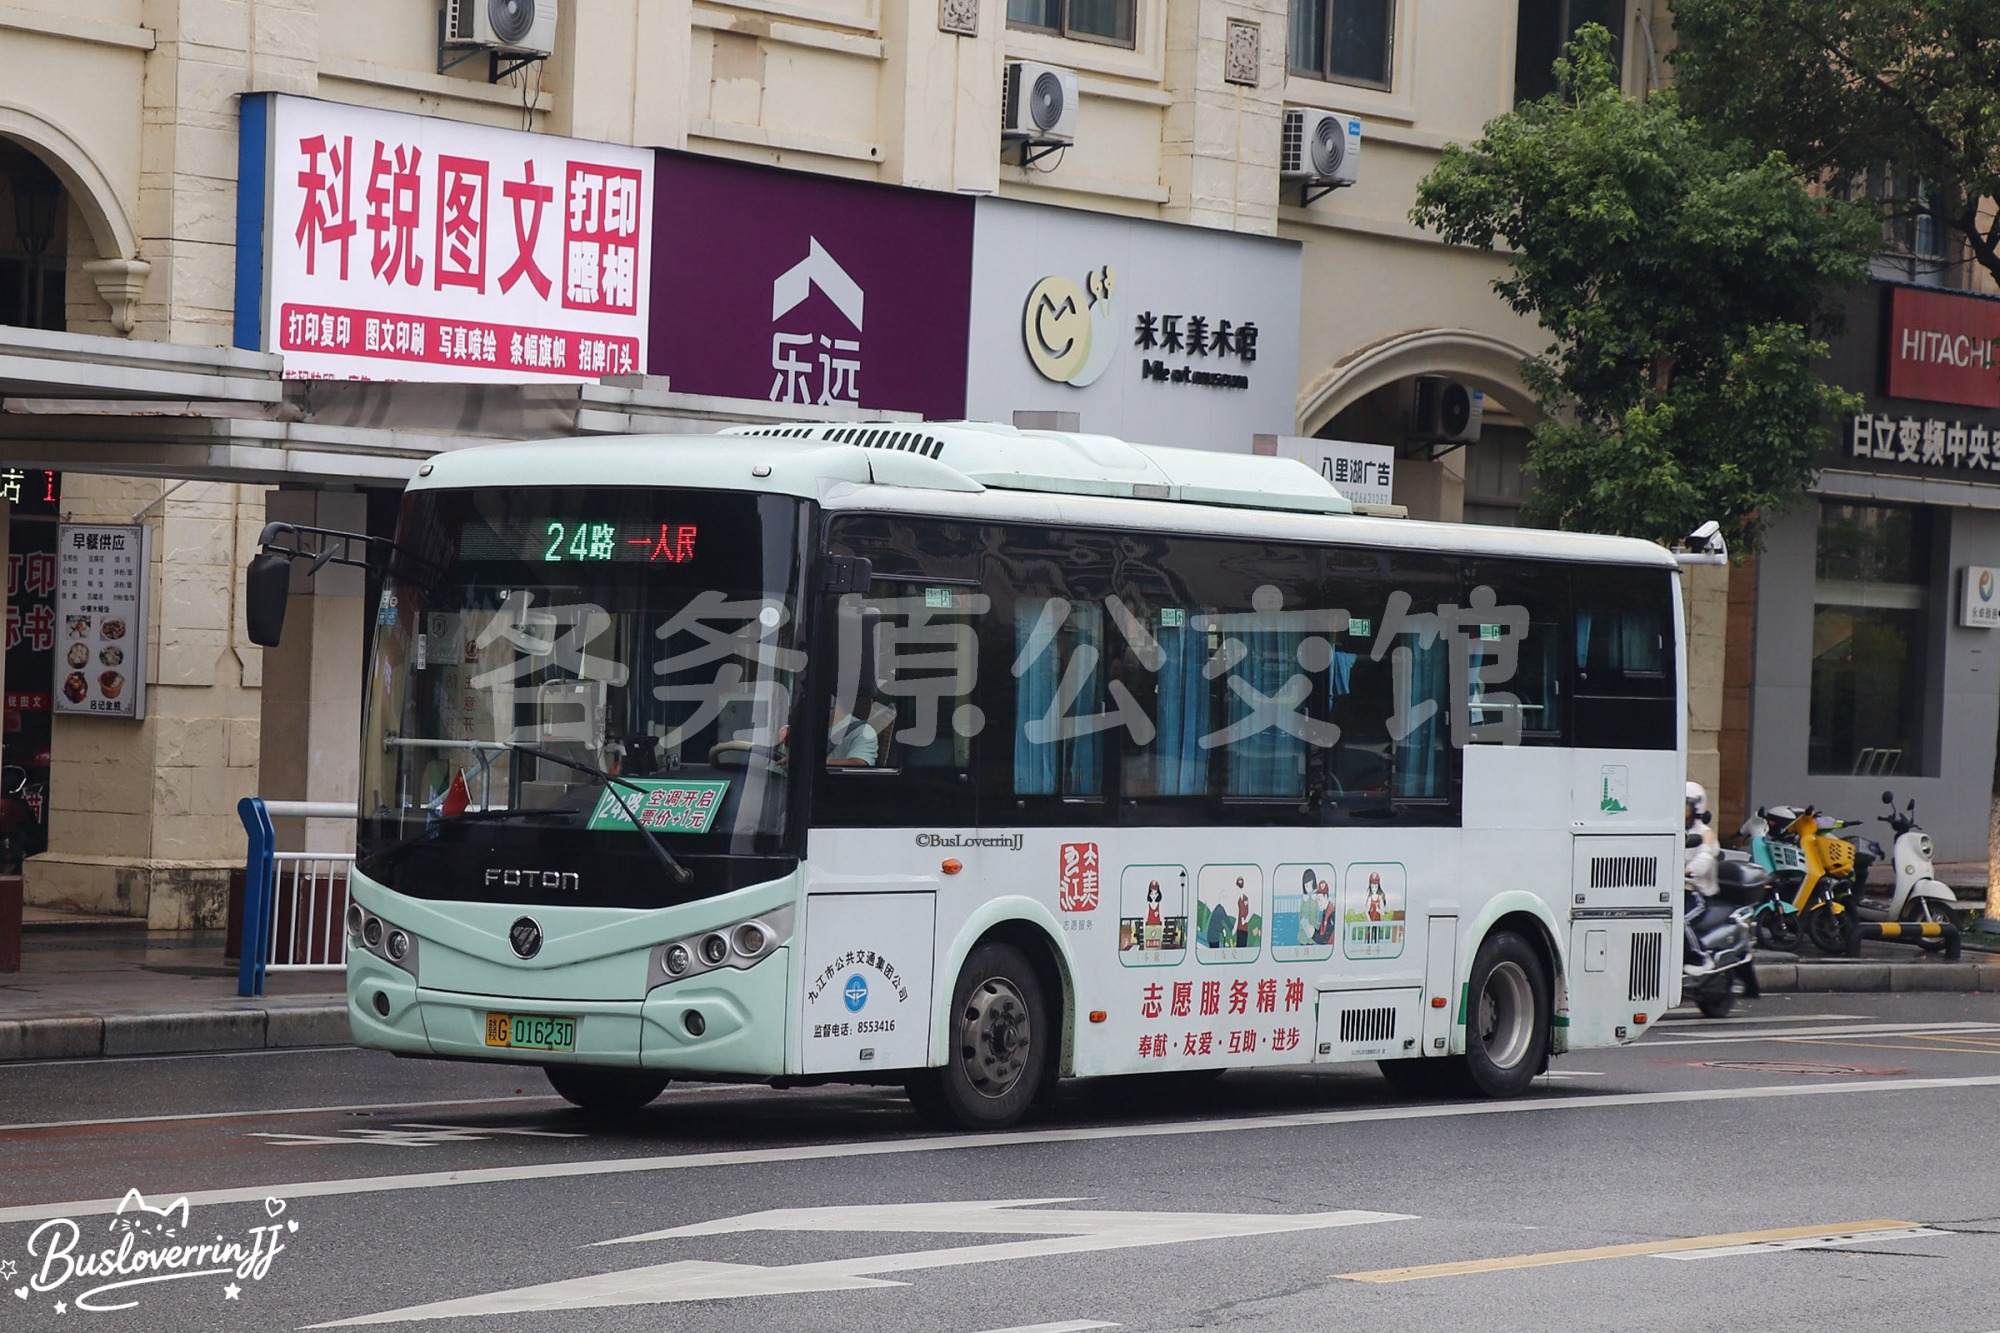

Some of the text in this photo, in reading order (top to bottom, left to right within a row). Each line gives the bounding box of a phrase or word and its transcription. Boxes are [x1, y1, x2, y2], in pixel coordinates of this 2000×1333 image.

[295, 134, 553, 302] 科锐图文
[569, 169, 637, 237] 打印
[566, 240, 635, 308] 照相
[288, 310, 632, 375] 打印复印 图文印刷 写真喷绘 条幅旗帜 招牌门头
[1134, 310, 1259, 361] 米乐美术馆
[1901, 327, 1992, 371] HITACHI
[768, 332, 861, 409] 乐远
[1321, 456, 1390, 486] 八里湖广告
[73, 532, 126, 550] 早餐供应
[545, 522, 616, 562] 24路
[639, 808, 706, 829] 票价+1元
[646, 789, 717, 808] 空调开启
[485, 868, 579, 891] FOTON
[807, 949, 909, 1005] 九江市公共交通集团公司
[1140, 977, 1305, 1019] 志愿服务精神
[857, 1019, 896, 1034] 8553416
